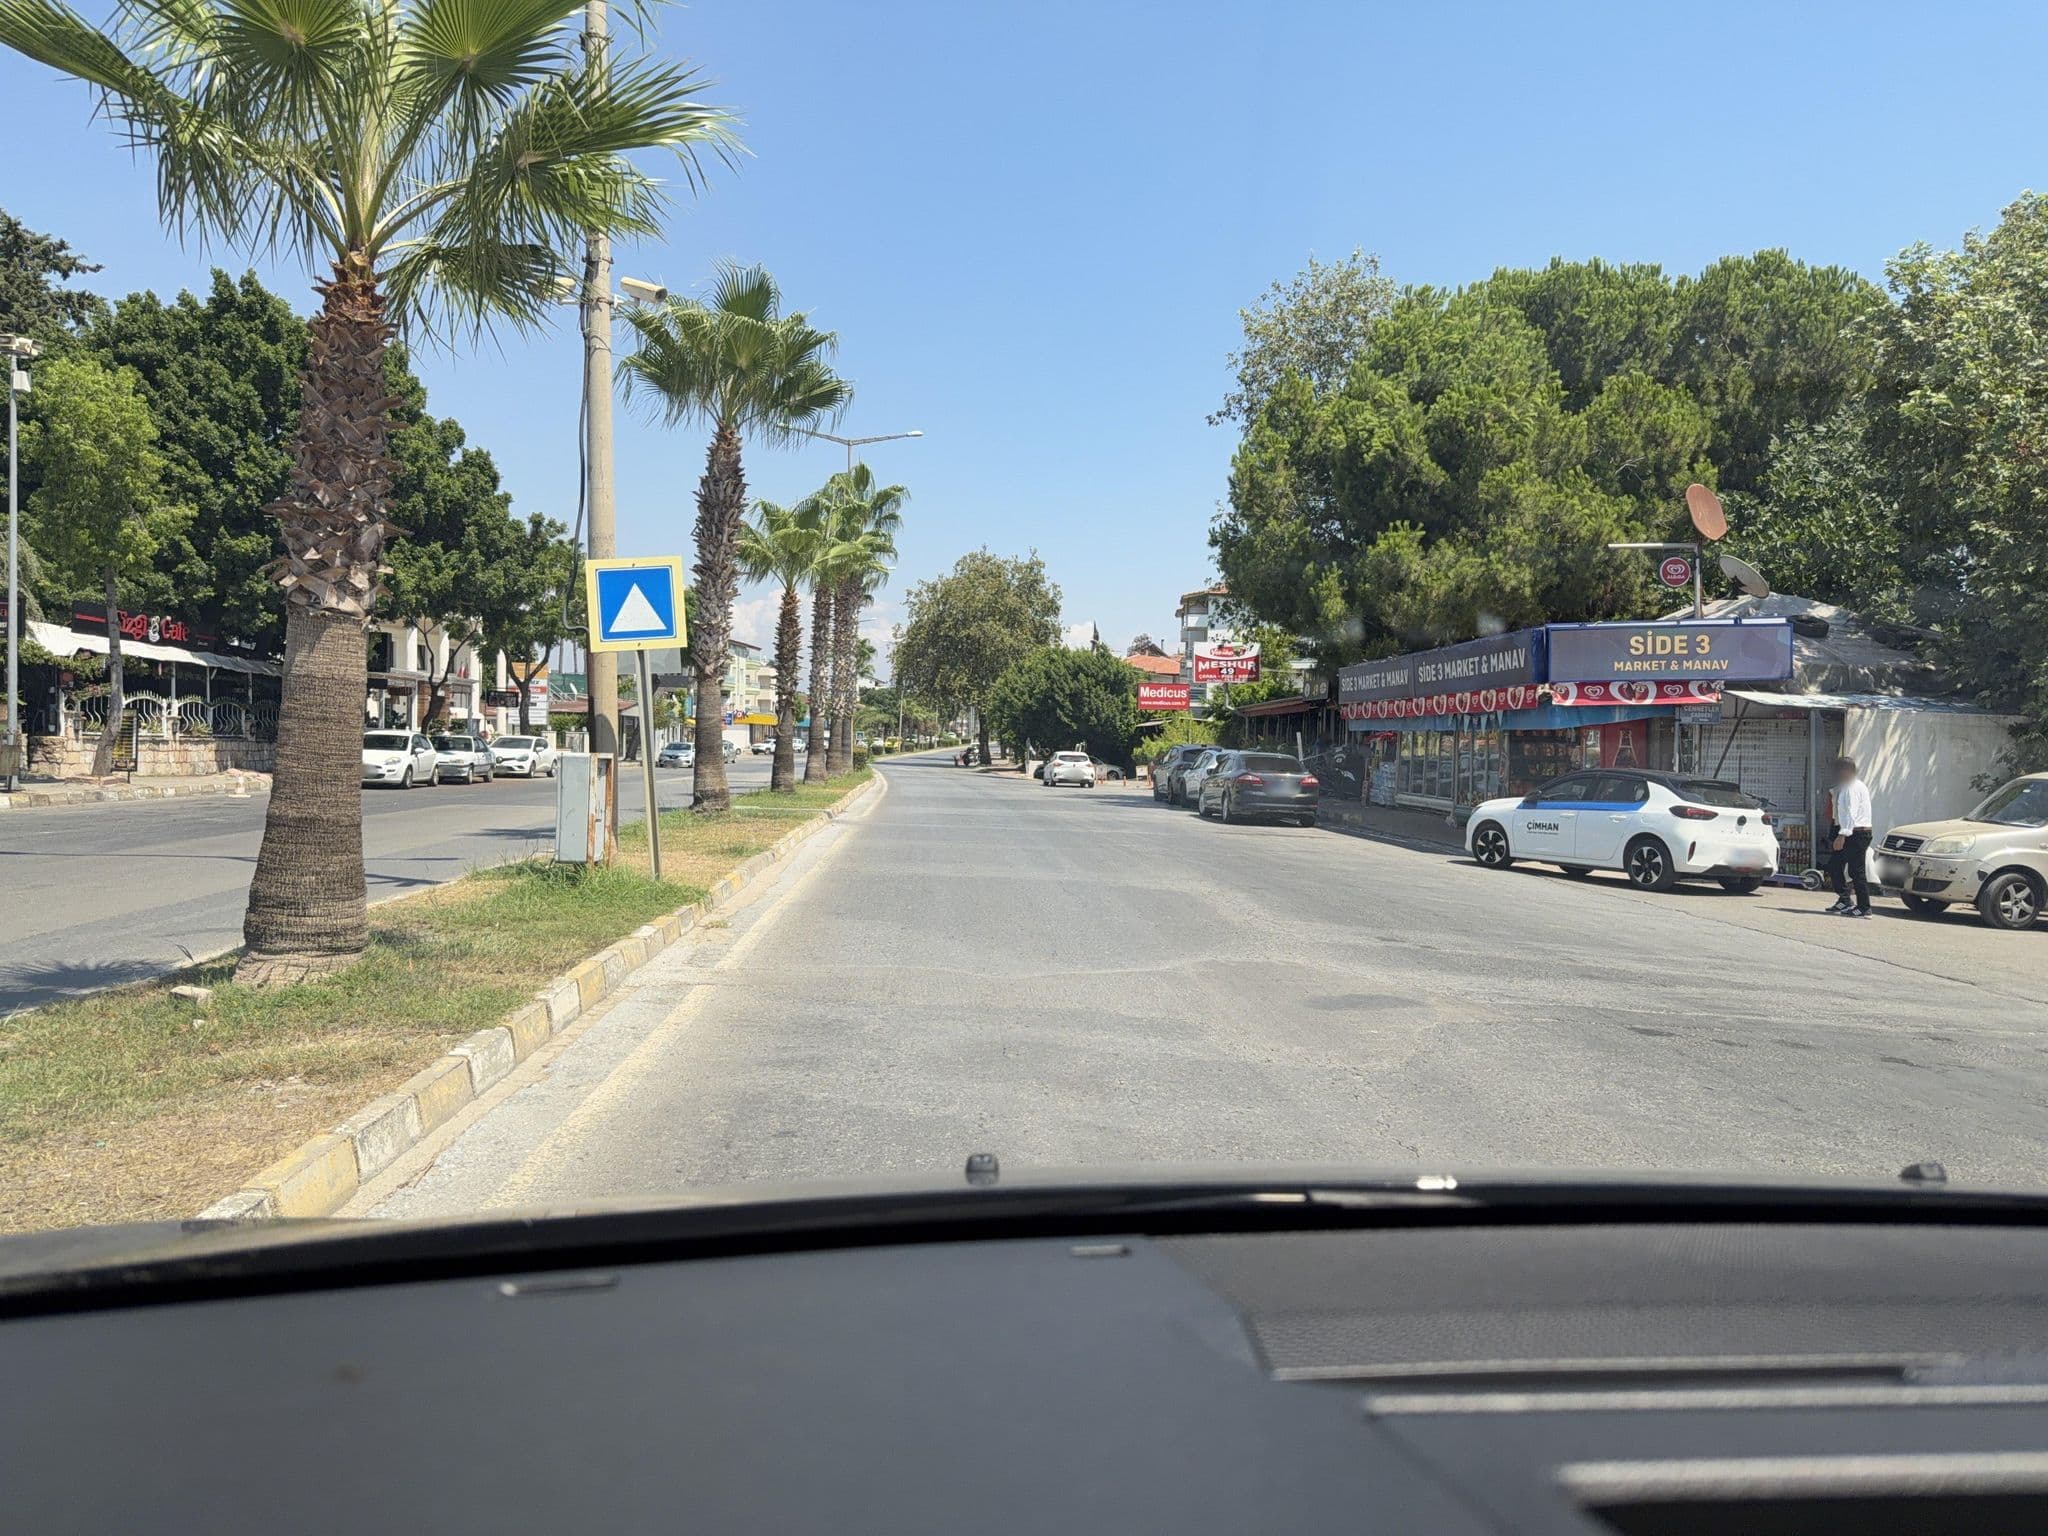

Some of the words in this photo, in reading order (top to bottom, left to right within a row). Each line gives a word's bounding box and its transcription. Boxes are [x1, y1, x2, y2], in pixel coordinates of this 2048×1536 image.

[1629, 630, 1689, 656] SİDE
[1695, 634, 1711, 655] 3
[1220, 667, 1235, 675] 49
[1418, 661, 1436, 683] SİDE
[1436, 663, 1443, 681] 3
[1444, 656, 1480, 680] MARKET
[1481, 654, 1489, 674] &
[1490, 647, 1526, 673] MANAV
[1614, 660, 1667, 672] MARKET
[1670, 660, 1679, 671] &
[1683, 660, 1729, 671] MANAV
[1341, 674, 1353, 692] SİDE
[1358, 673, 1380, 690] MARKET
[1386, 669, 1409, 687] MANAV
[1140, 686, 1188, 698] Medicus
[1526, 818, 1560, 832] ÇİMHAN
